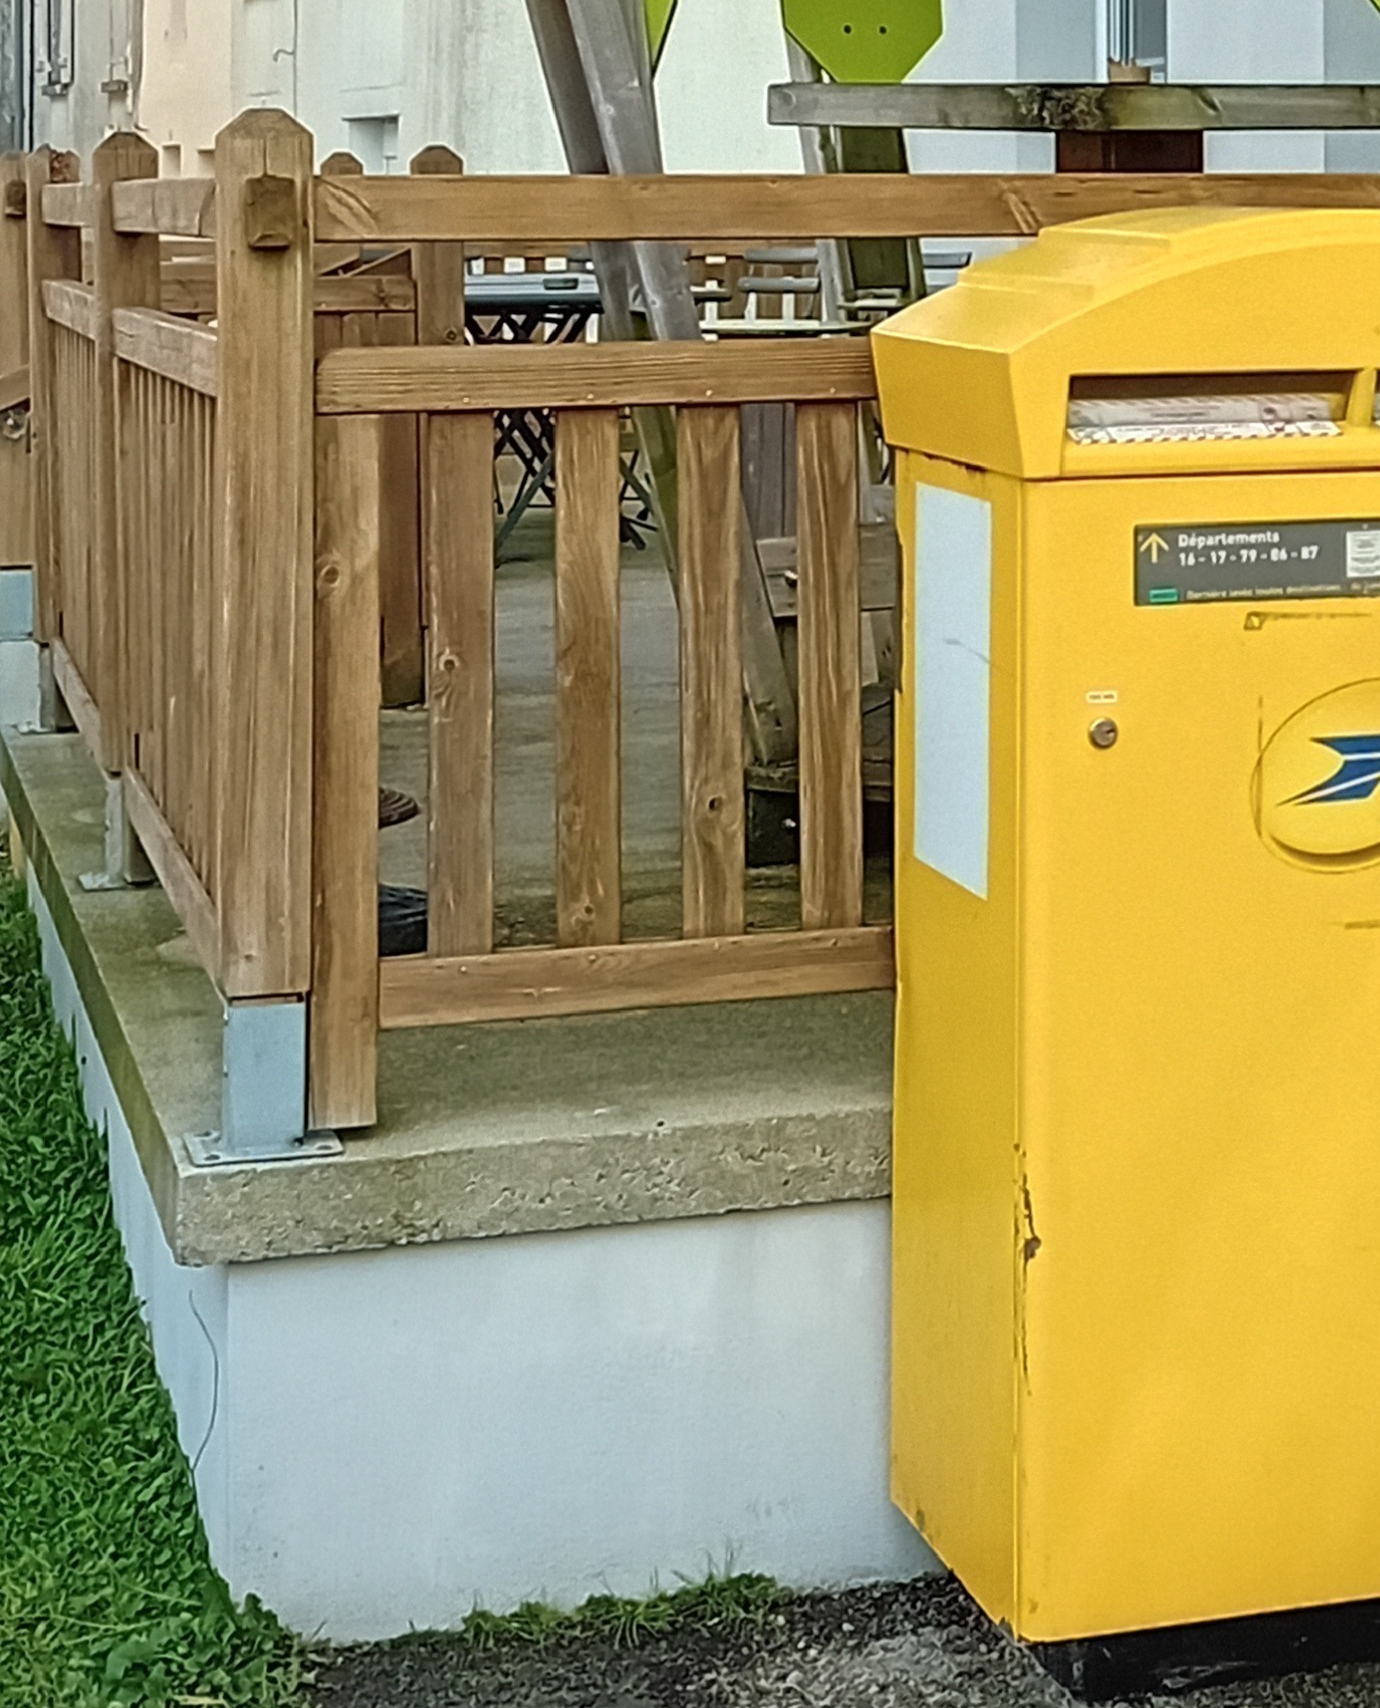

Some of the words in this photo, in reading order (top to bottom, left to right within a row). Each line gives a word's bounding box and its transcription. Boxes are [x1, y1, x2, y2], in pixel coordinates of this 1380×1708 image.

[1177, 531, 1281, 550] Départements
[1178, 551, 1196, 567] 16
[1210, 549, 1227, 564] 17
